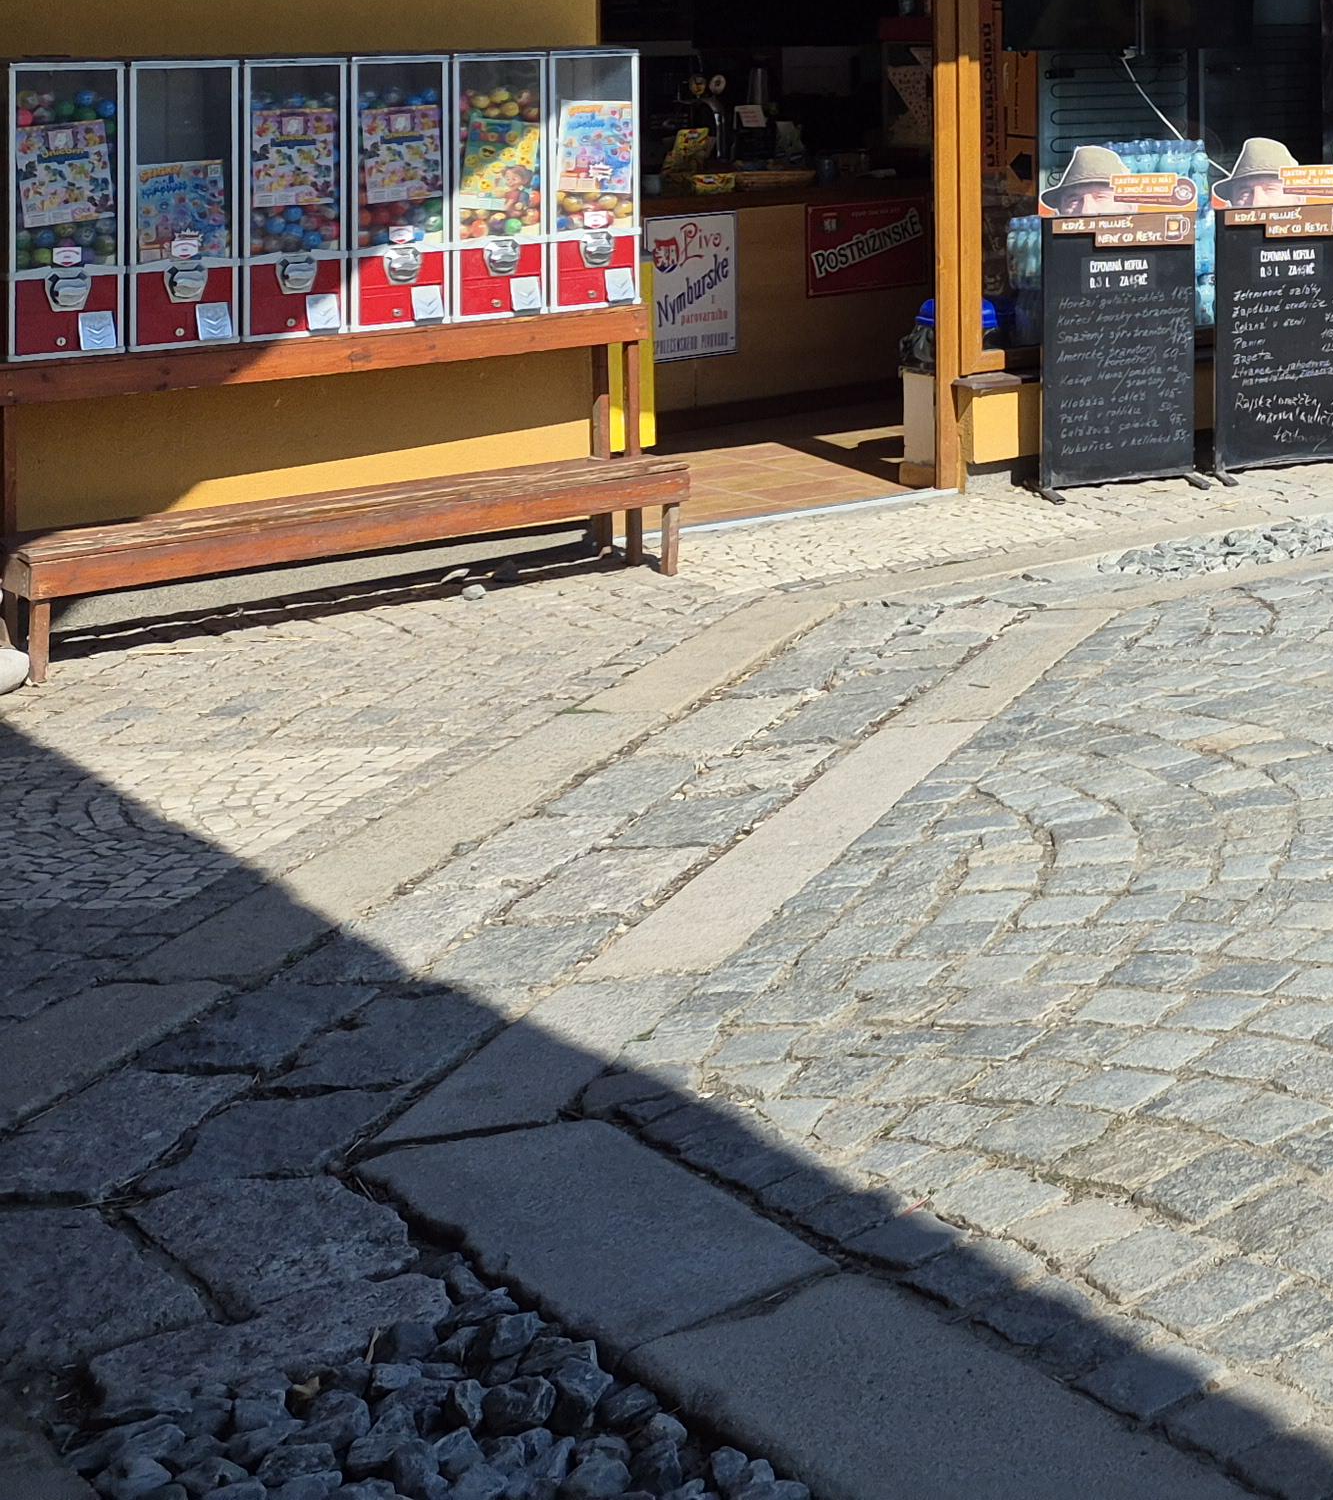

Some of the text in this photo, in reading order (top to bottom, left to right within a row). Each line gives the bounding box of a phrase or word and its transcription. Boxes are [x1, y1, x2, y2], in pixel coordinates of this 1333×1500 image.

[980, 23, 995, 147] VELBLOUDŮ
[1234, 211, 1257, 222] KDYŽ
[1062, 218, 1085, 231] KDYŽ
[1291, 223, 1302, 233] CO
[680, 221, 722, 268] Pivo
[814, 209, 922, 278] POSTŘIŽINSKÉ
[1097, 233, 1120, 244] NENÍ
[1122, 233, 1134, 243] CO
[1124, 259, 1149, 272] KOFOLA
[1288, 264, 1298, 277] ZA
[657, 246, 730, 328] Nymburské
[1105, 276, 1111, 288] L
[1119, 274, 1130, 287] ZA
[1234, 392, 1276, 412] Rajská
[1060, 440, 1114, 456] Kukuřice
